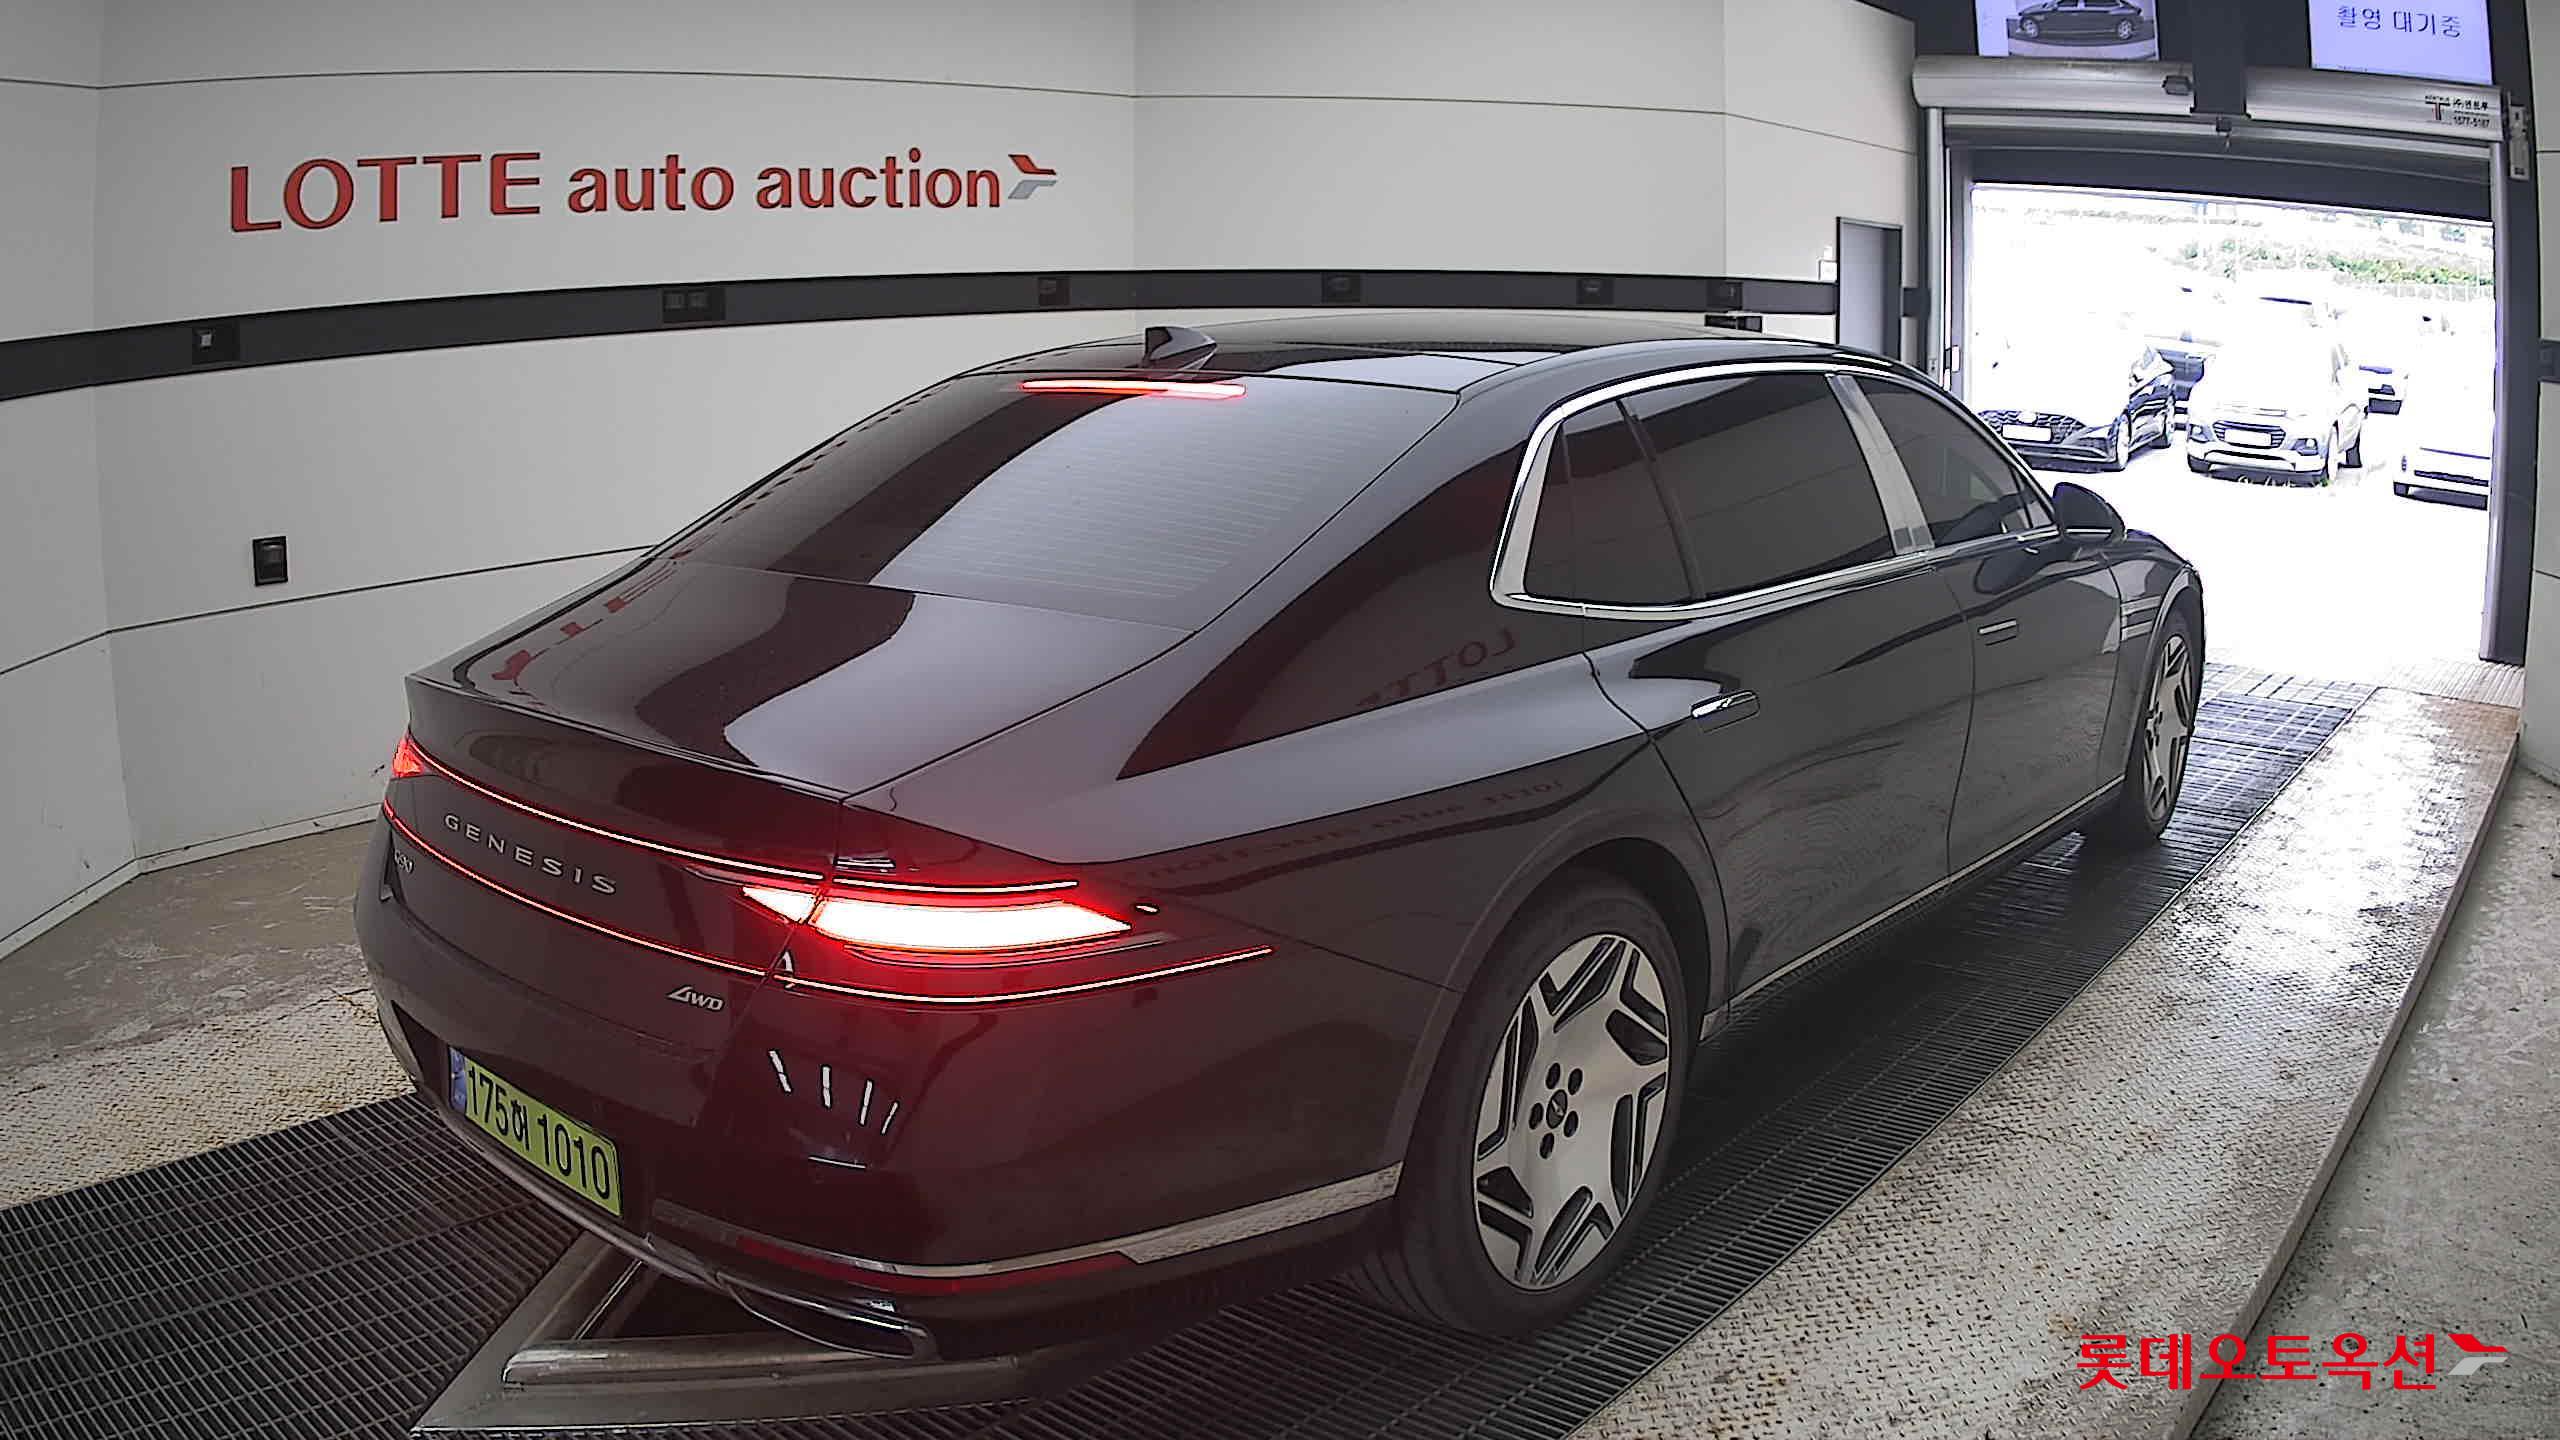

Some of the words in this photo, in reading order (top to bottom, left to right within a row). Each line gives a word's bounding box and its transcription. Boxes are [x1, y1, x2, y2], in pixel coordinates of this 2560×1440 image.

[2338, 5, 2382, 30] 촬영
[2393, 11, 2461, 38] 대기중
[230, 153, 541, 233] LOTTE
[568, 154, 736, 213] auto
[756, 147, 1002, 210] auction
[444, 814, 617, 895] GENESIS
[667, 985, 723, 1011] 4WD
[537, 1113, 610, 1200] 1010
